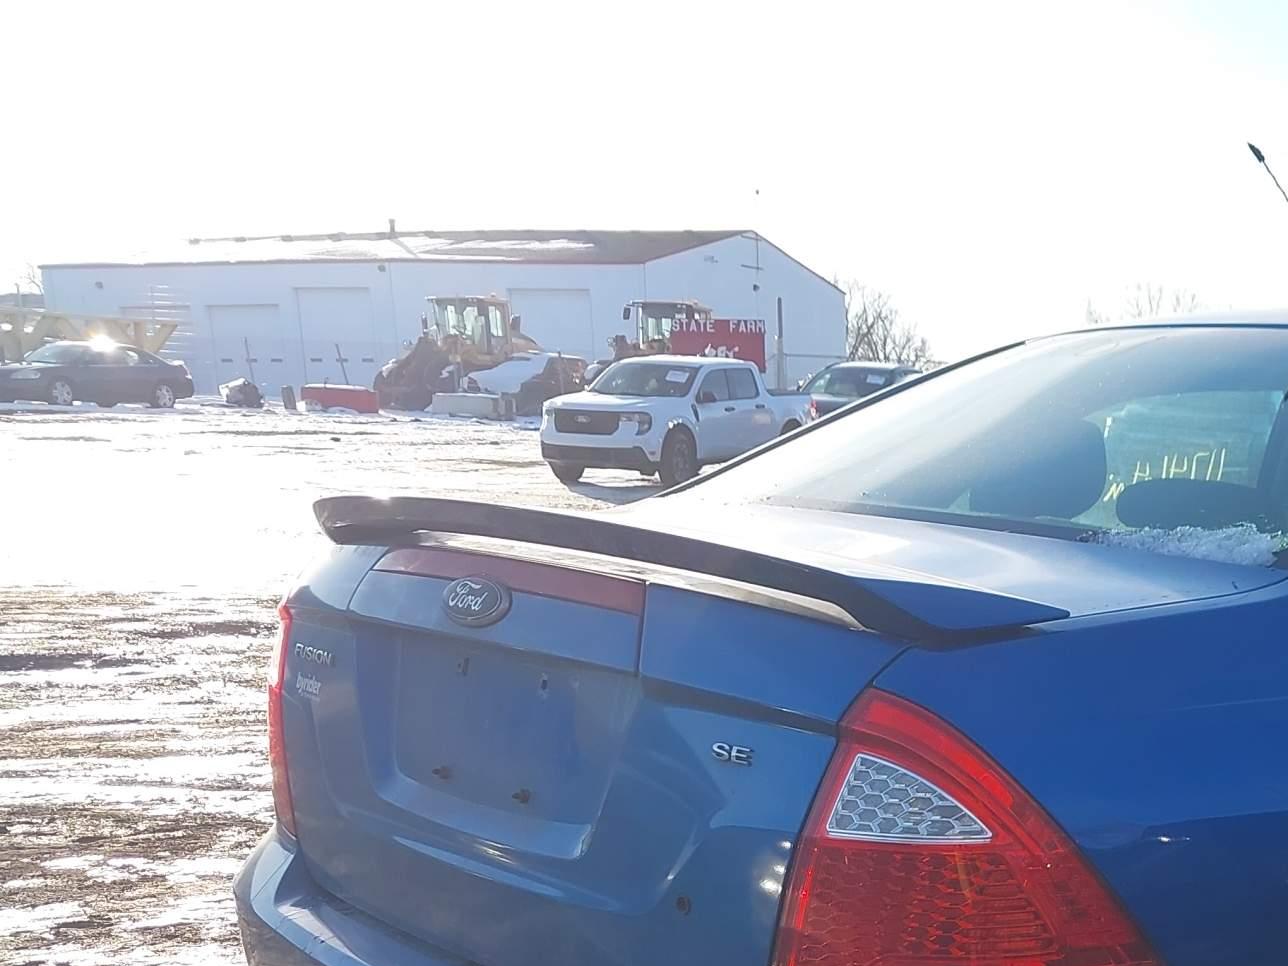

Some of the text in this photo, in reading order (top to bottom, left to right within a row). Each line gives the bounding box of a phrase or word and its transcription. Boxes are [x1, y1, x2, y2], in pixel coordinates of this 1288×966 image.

[672, 319, 716, 333] STATE
[448, 580, 489, 612] Ford
[294, 642, 332, 665] FUSION
[711, 742, 751, 765] SE
